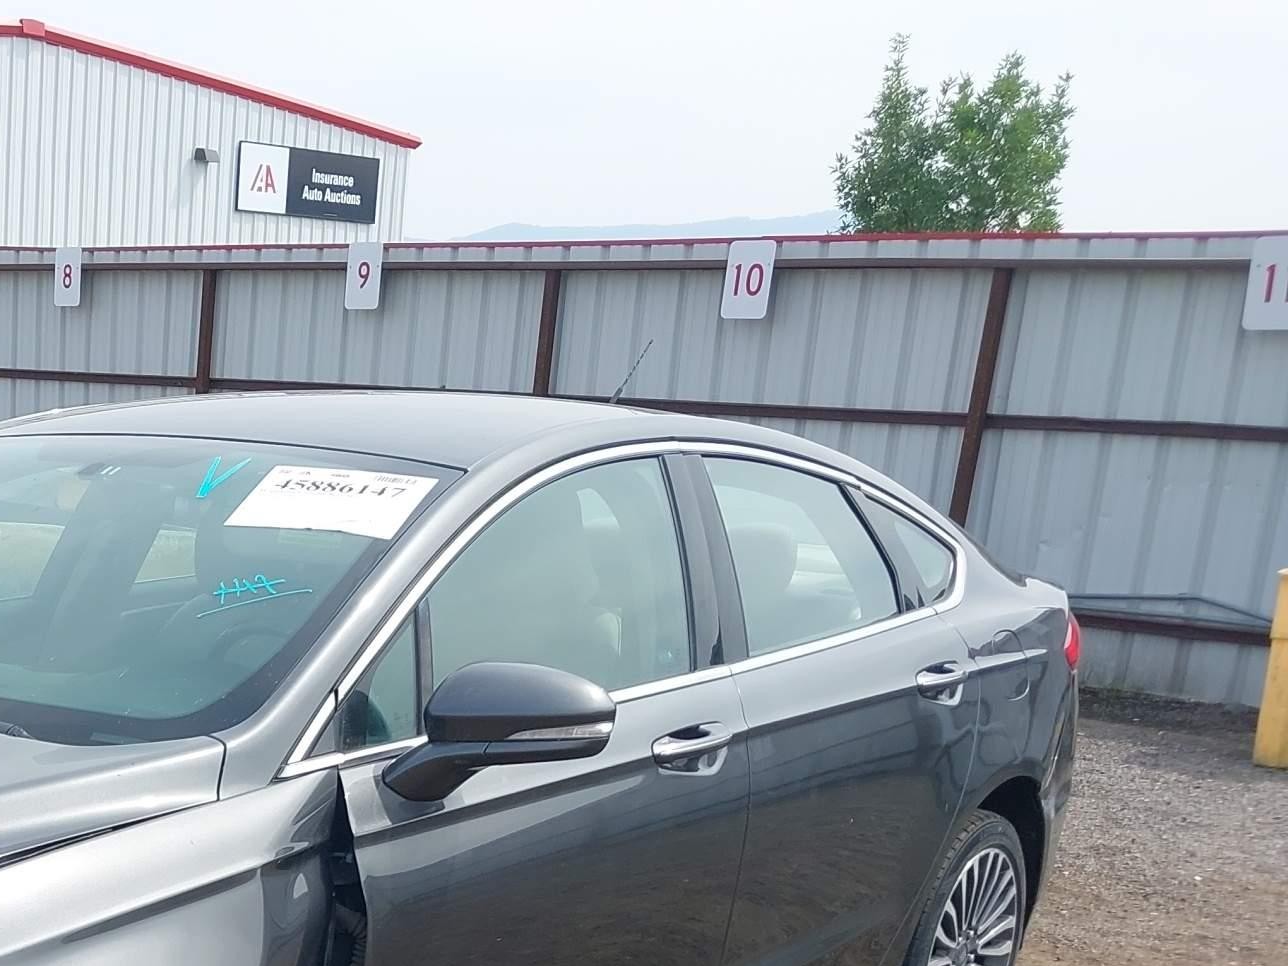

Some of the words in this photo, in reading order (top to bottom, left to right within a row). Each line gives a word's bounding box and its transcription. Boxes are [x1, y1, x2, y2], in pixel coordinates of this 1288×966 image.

[312, 168, 354, 187] Insurance
[302, 185, 323, 202] Auto
[324, 187, 361, 205] Auctions
[62, 263, 72, 289] 8
[358, 261, 371, 289] 9
[733, 263, 764, 297] 10
[1264, 263, 1288, 304] 1
[274, 478, 407, 498] 45886147
